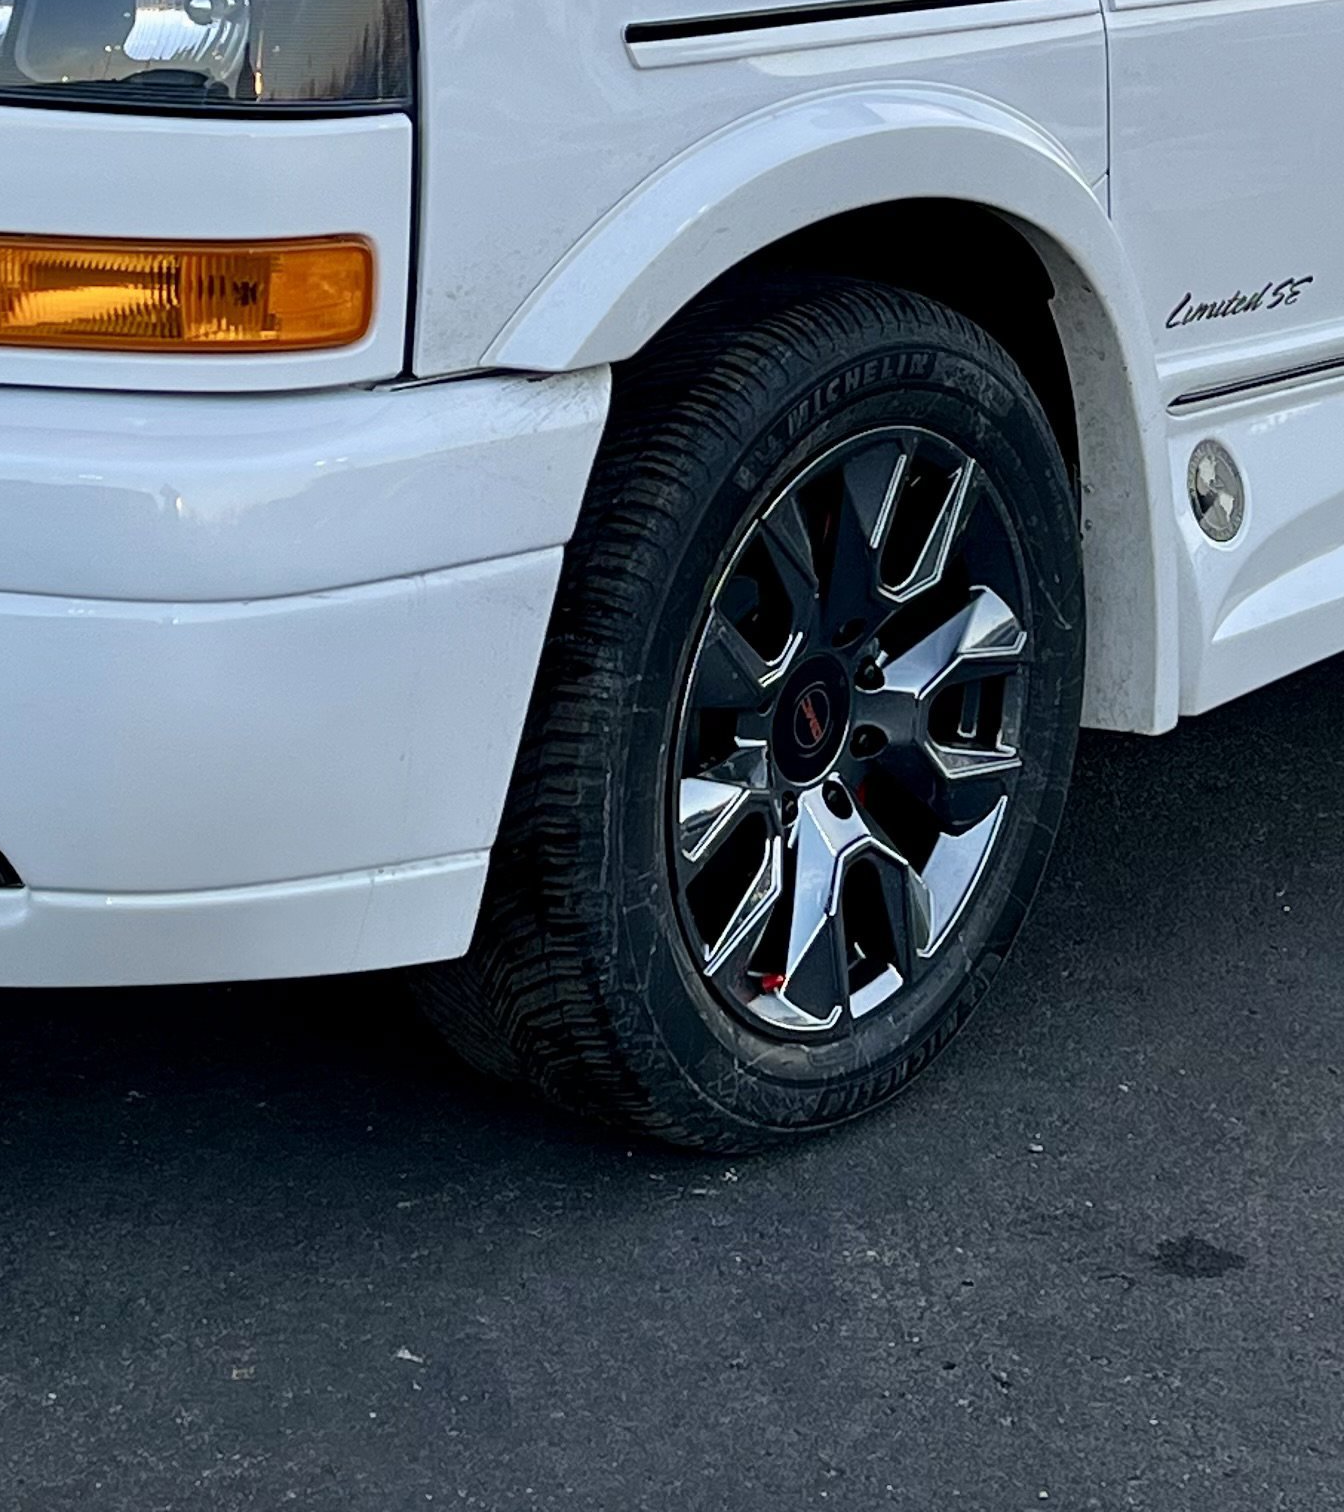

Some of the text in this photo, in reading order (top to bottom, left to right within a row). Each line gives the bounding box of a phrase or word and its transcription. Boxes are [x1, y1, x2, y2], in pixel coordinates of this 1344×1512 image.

[1165, 275, 1314, 329] Limited SE
[787, 351, 931, 437] MICHELIN
